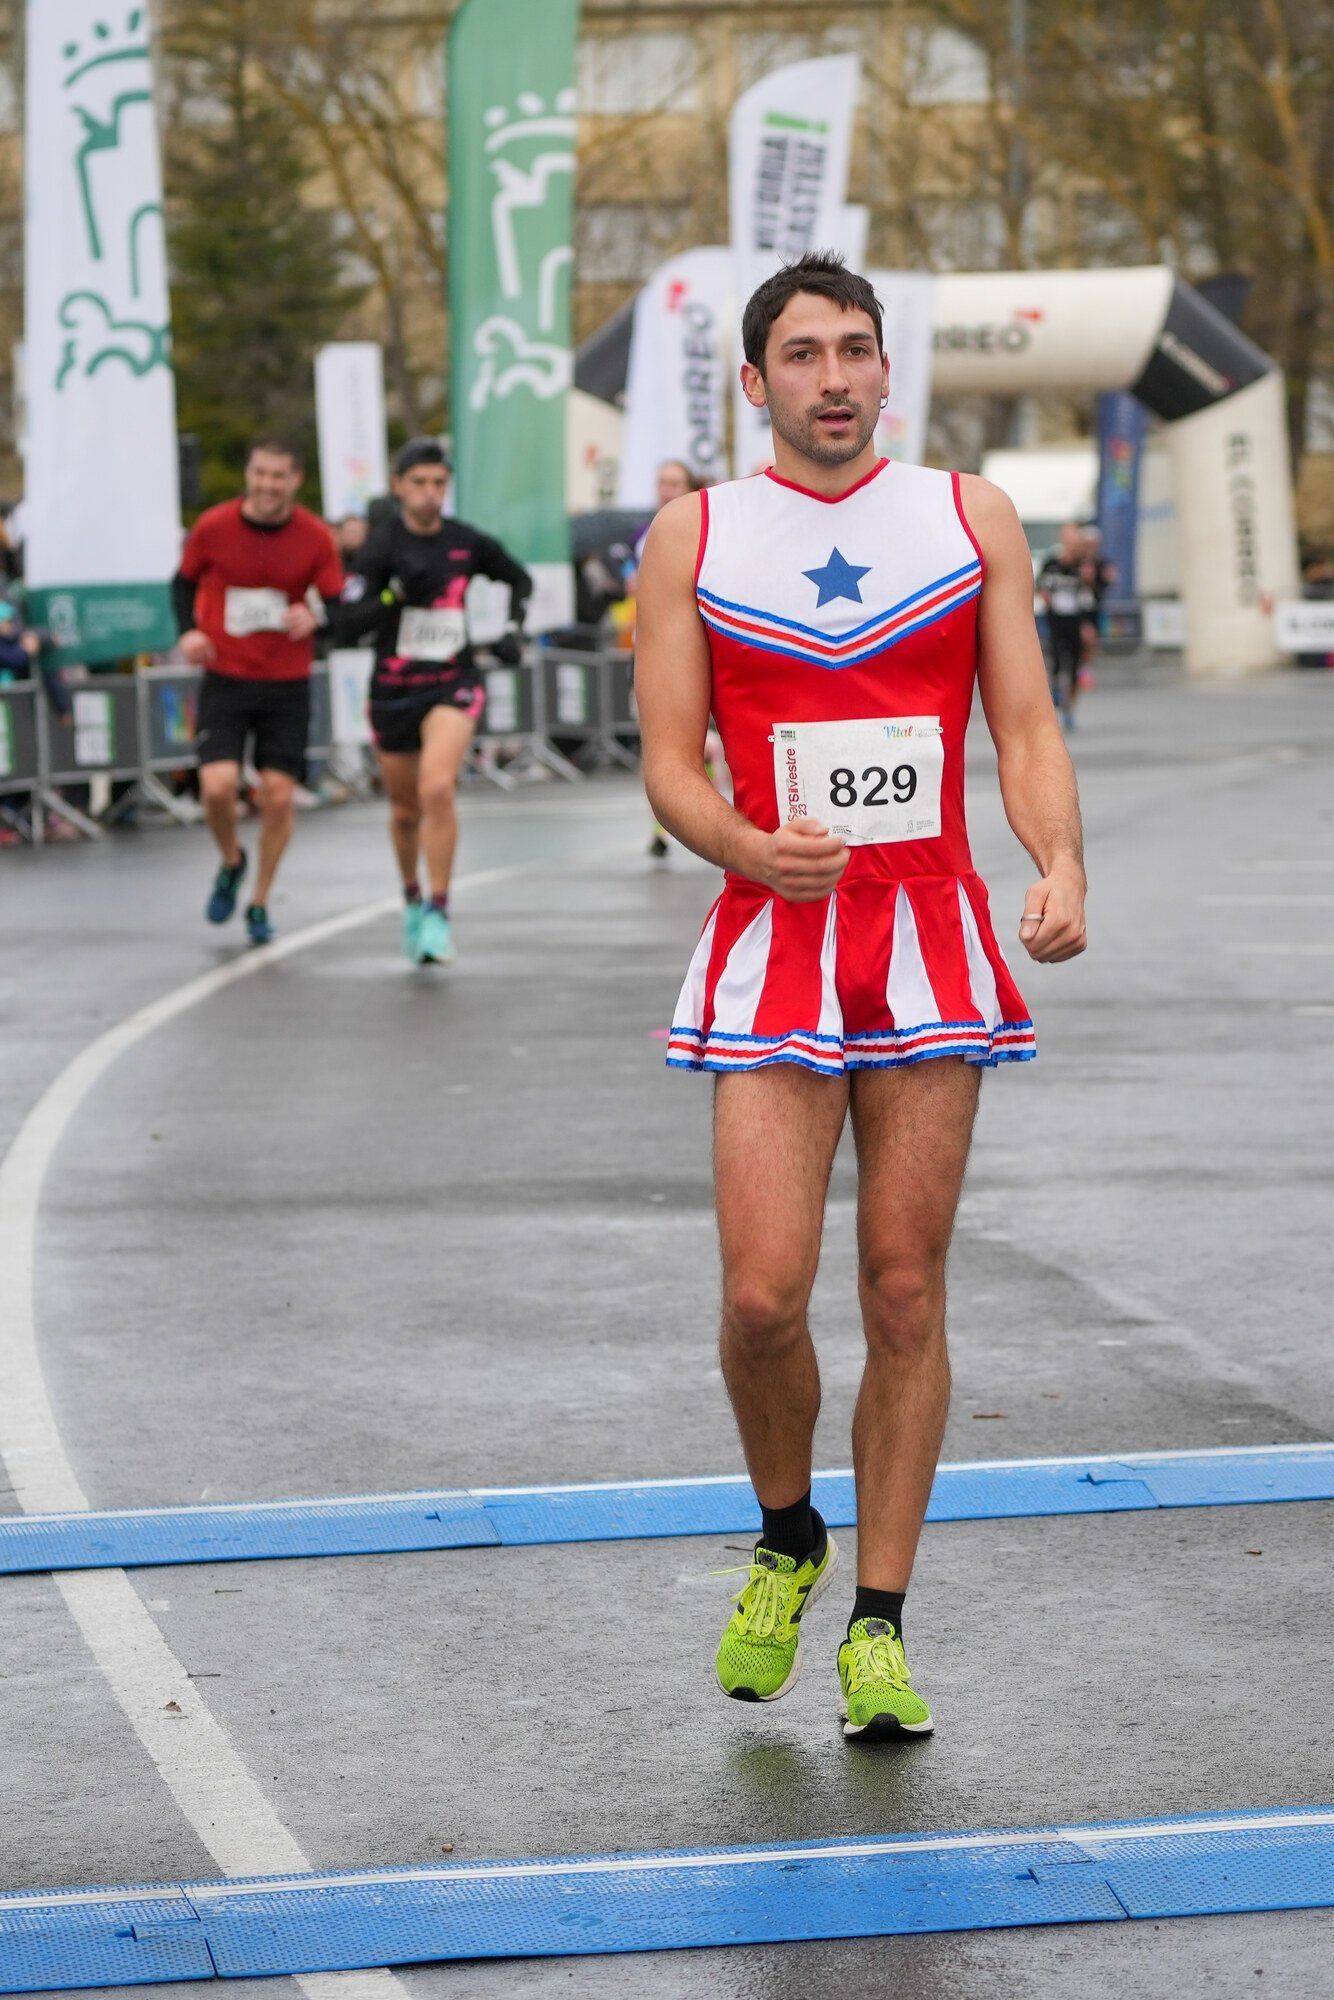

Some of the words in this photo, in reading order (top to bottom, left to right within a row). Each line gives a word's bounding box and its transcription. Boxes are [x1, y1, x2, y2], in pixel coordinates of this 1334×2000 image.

[682, 302, 716, 478] ORREO
[882, 724, 914, 739] Vital
[829, 764, 918, 808] 829
[798, 803, 808, 816] 23
